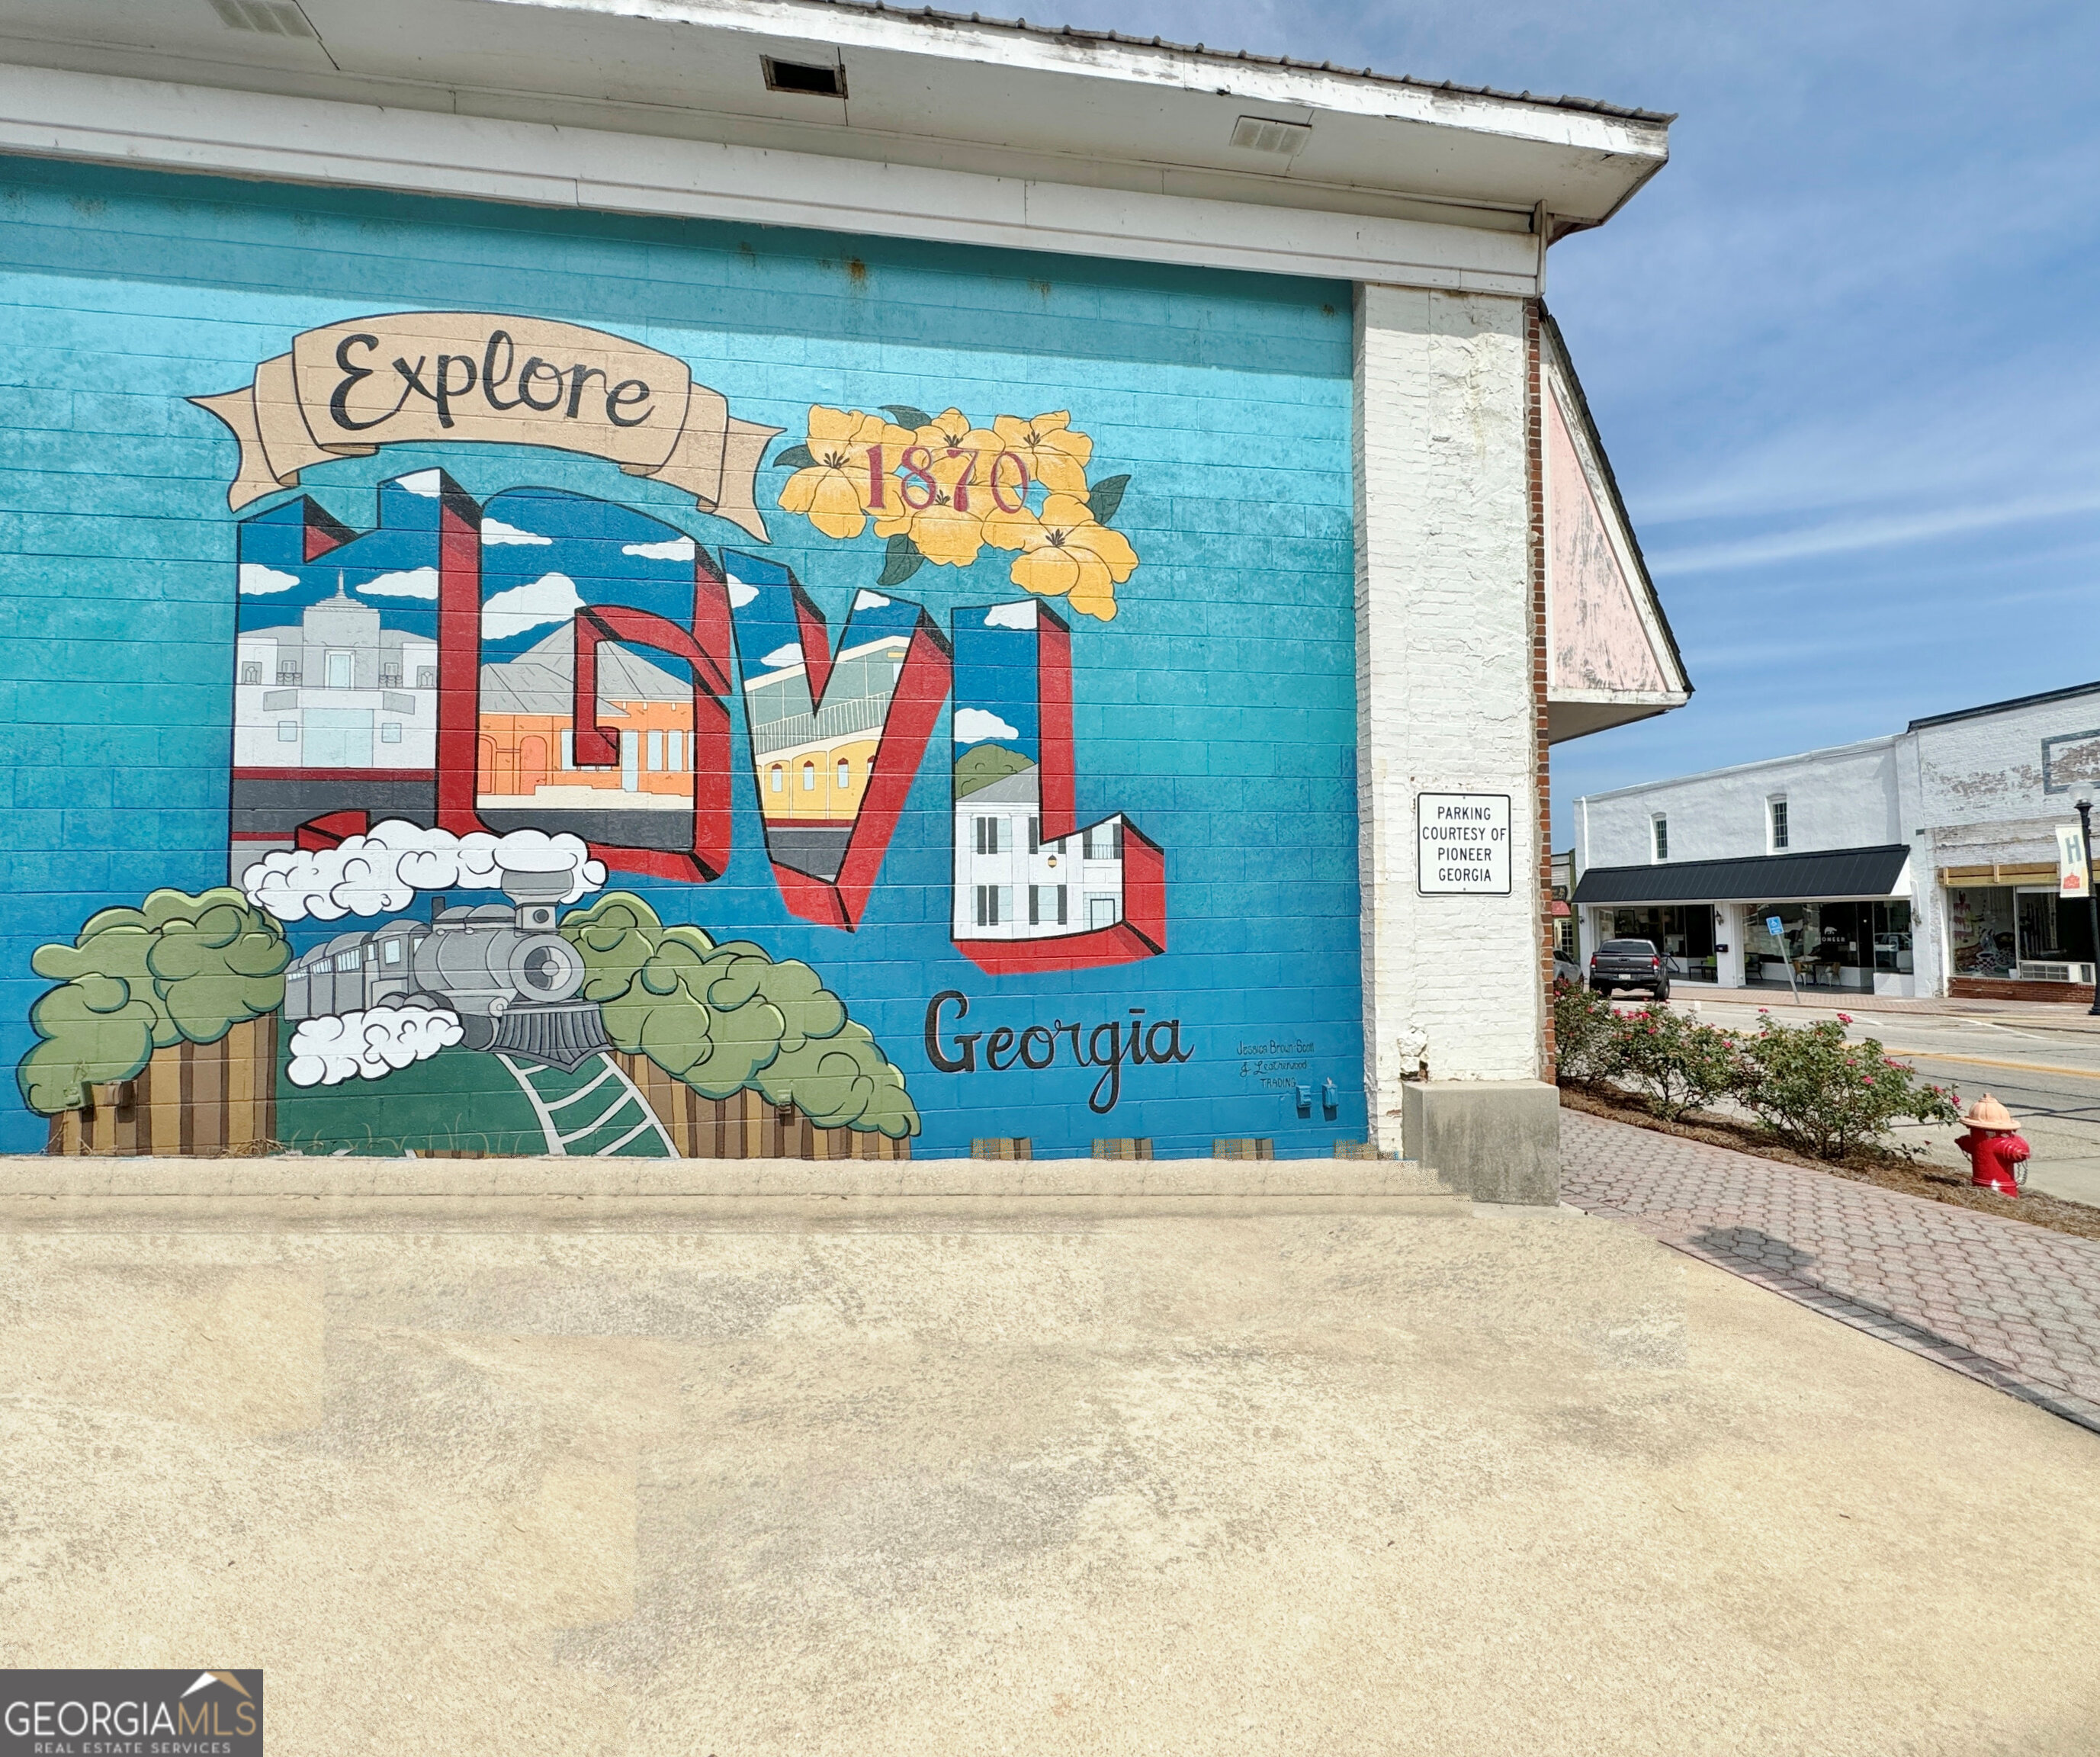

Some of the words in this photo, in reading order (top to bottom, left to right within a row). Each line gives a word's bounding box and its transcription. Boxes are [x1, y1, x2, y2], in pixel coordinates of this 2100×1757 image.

[329, 329, 655, 432] Explore
[865, 444, 1030, 515] 1870
[1437, 806, 1491, 821] PARKING
[1422, 826, 1486, 841] COURTESY
[1491, 827, 1507, 841] OF
[1437, 847, 1492, 862] PIONEER
[2064, 834, 2082, 864] H
[1438, 868, 1492, 882] GEORGIA
[924, 990, 1195, 1114] Georgia
[1237, 1040, 1267, 1055] Jessica
[1253, 1059, 1308, 1075] Leatherwood
[1260, 1076, 1296, 1089] TRADING
